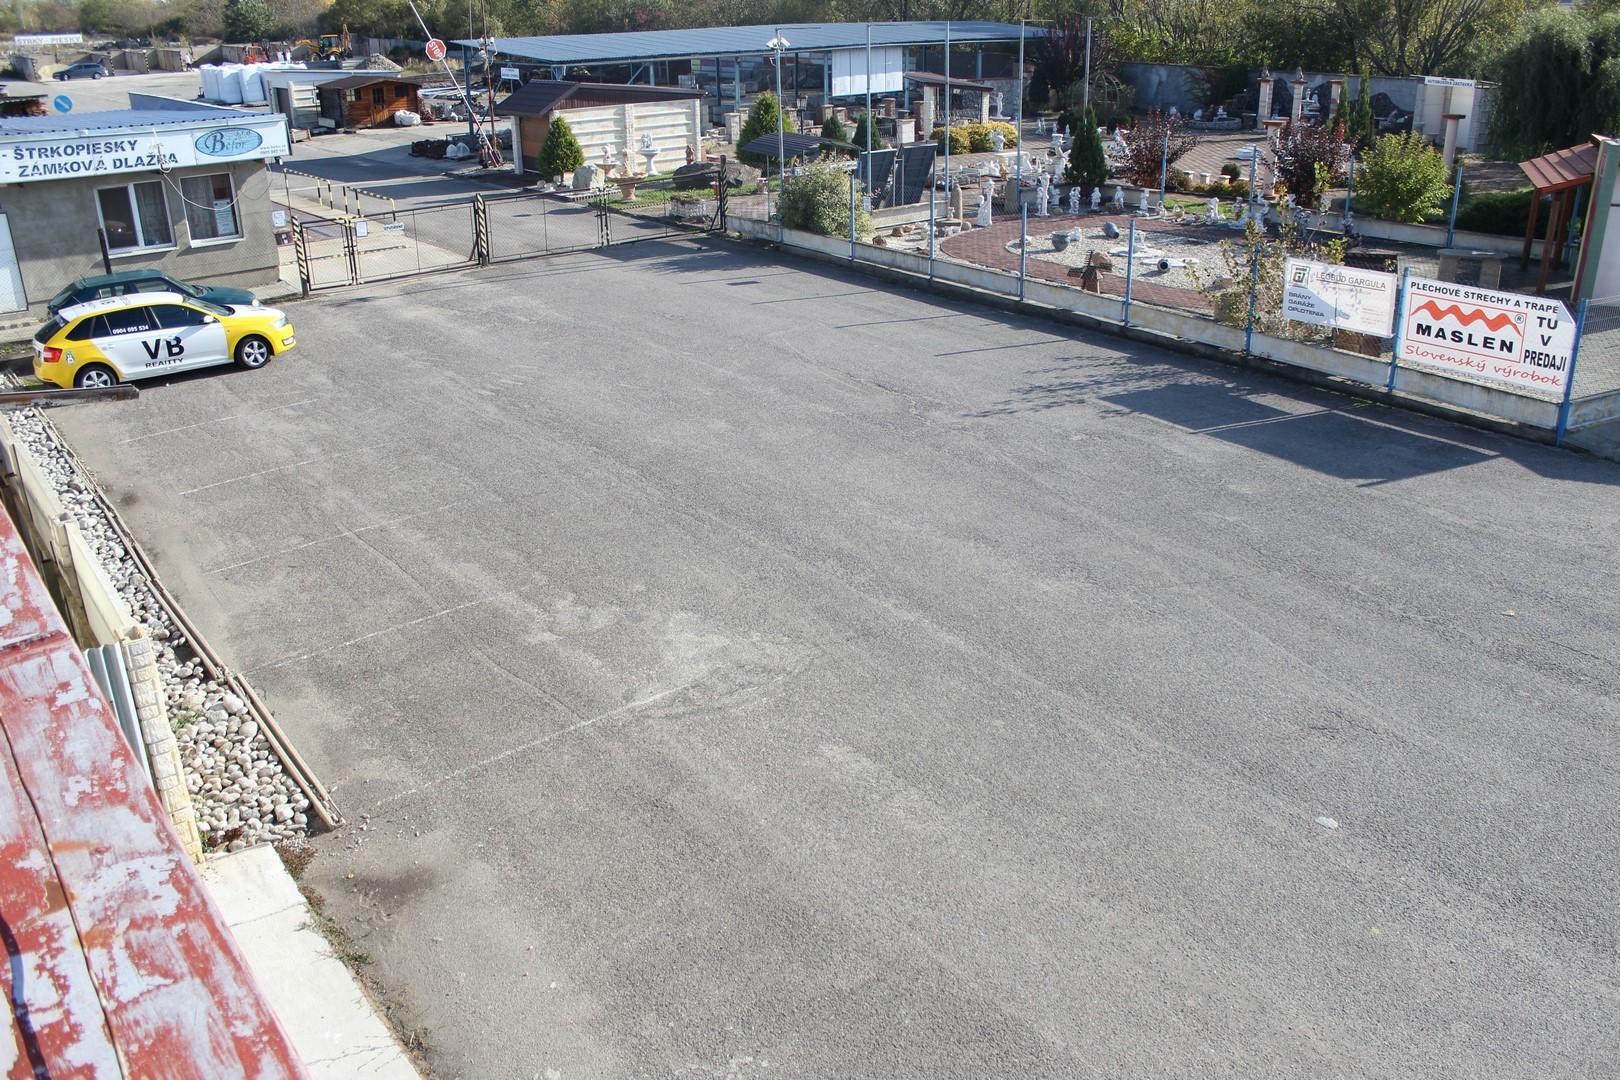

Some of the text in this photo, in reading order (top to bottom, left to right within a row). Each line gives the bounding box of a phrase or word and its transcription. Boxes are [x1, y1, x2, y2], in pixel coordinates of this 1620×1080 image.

[429, 41, 443, 58] STOP
[14, 139, 138, 161] ŠTRKOPIESKY
[204, 131, 246, 154] Befor
[18, 155, 108, 178] ZÁMKOVÁ
[1348, 278, 1386, 289] GARGULA
[1288, 291, 1311, 300] BRÁNY
[1288, 299, 1315, 308] GARÁŽE
[1410, 281, 1460, 297] PLECHOVÉ
[1463, 291, 1511, 306] STRECHY
[1513, 299, 1521, 307] A
[1288, 306, 1325, 317] OPLOTENIA
[112, 327, 126, 335] 0904
[1537, 316, 1558, 330] TU
[1415, 323, 1514, 353] MASLEN
[1540, 334, 1552, 347] V
[141, 336, 185, 360] VB
[1405, 344, 1562, 387] Slovenský výrobok
[1523, 349, 1567, 372] PREDAJI
